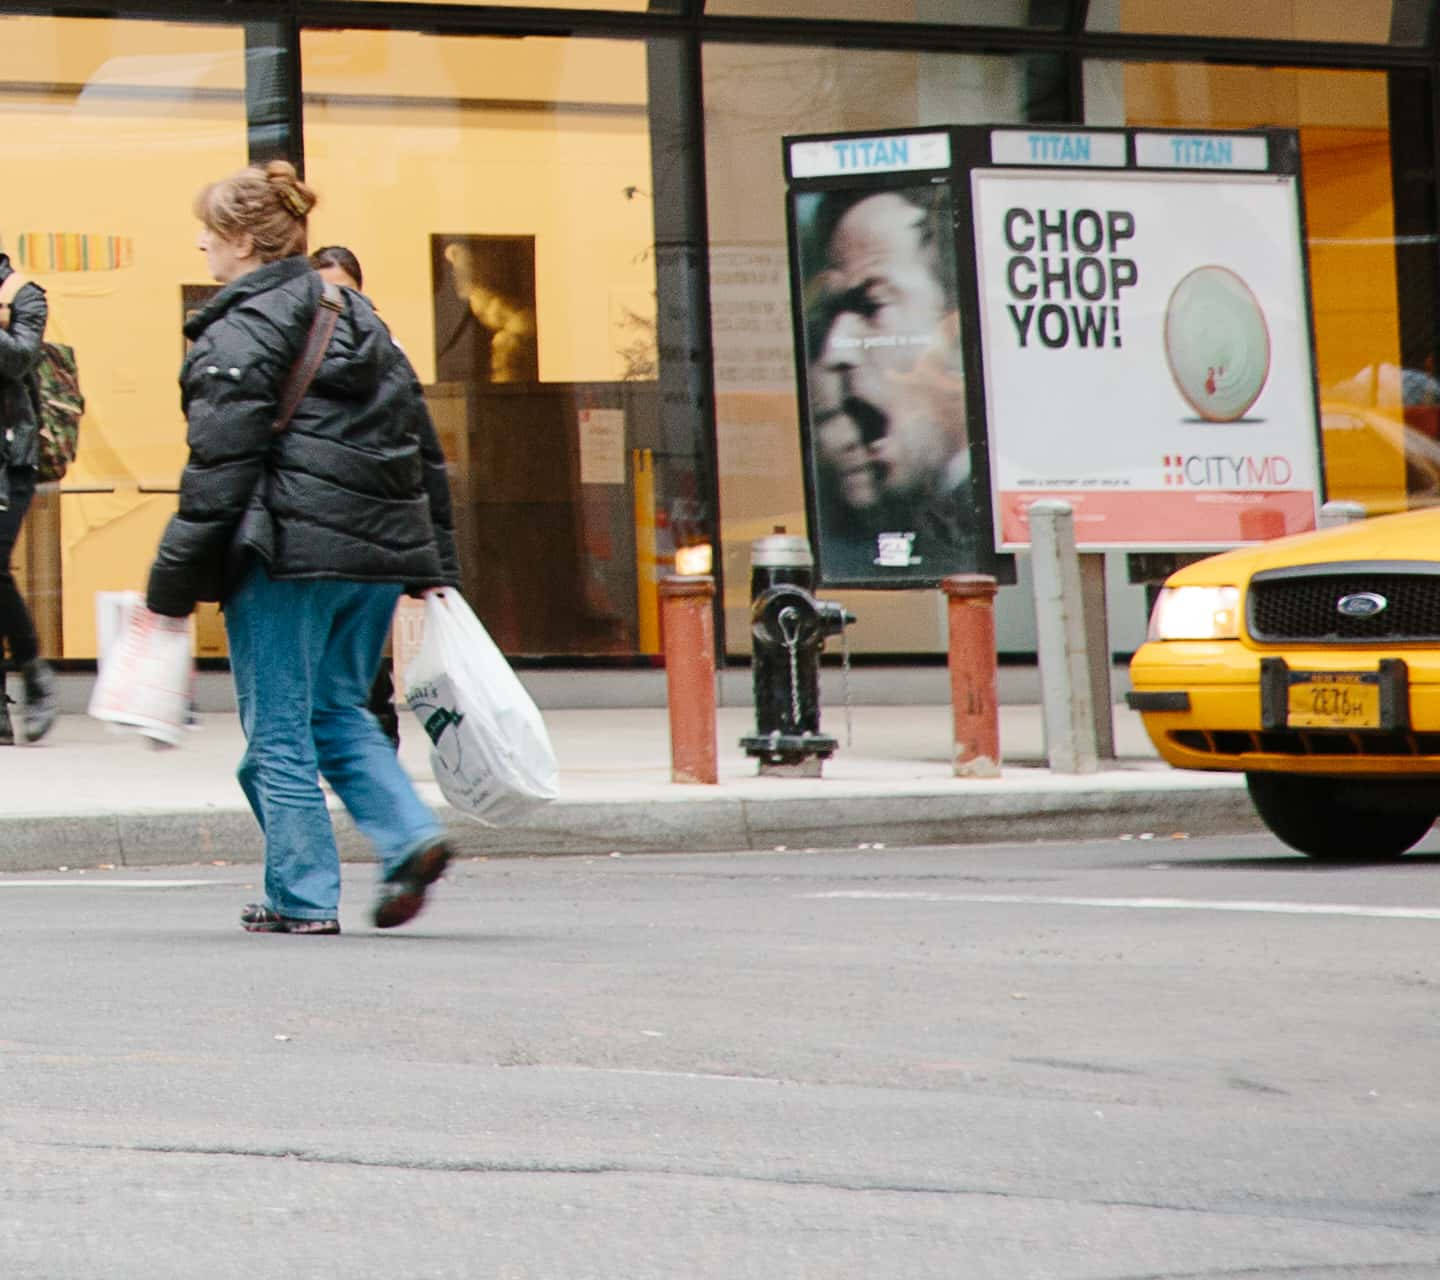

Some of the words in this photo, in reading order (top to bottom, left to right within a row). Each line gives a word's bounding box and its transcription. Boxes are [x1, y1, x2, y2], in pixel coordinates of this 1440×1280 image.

[832, 139, 908, 169] TITAN
[1027, 135, 1091, 161] TITAN
[1171, 139, 1233, 164] TITAN
[1004, 207, 1136, 254] CHOP
[1006, 255, 1140, 301] CHOP
[1007, 304, 1123, 349] YOW!
[1184, 456, 1293, 486] CITYMD
